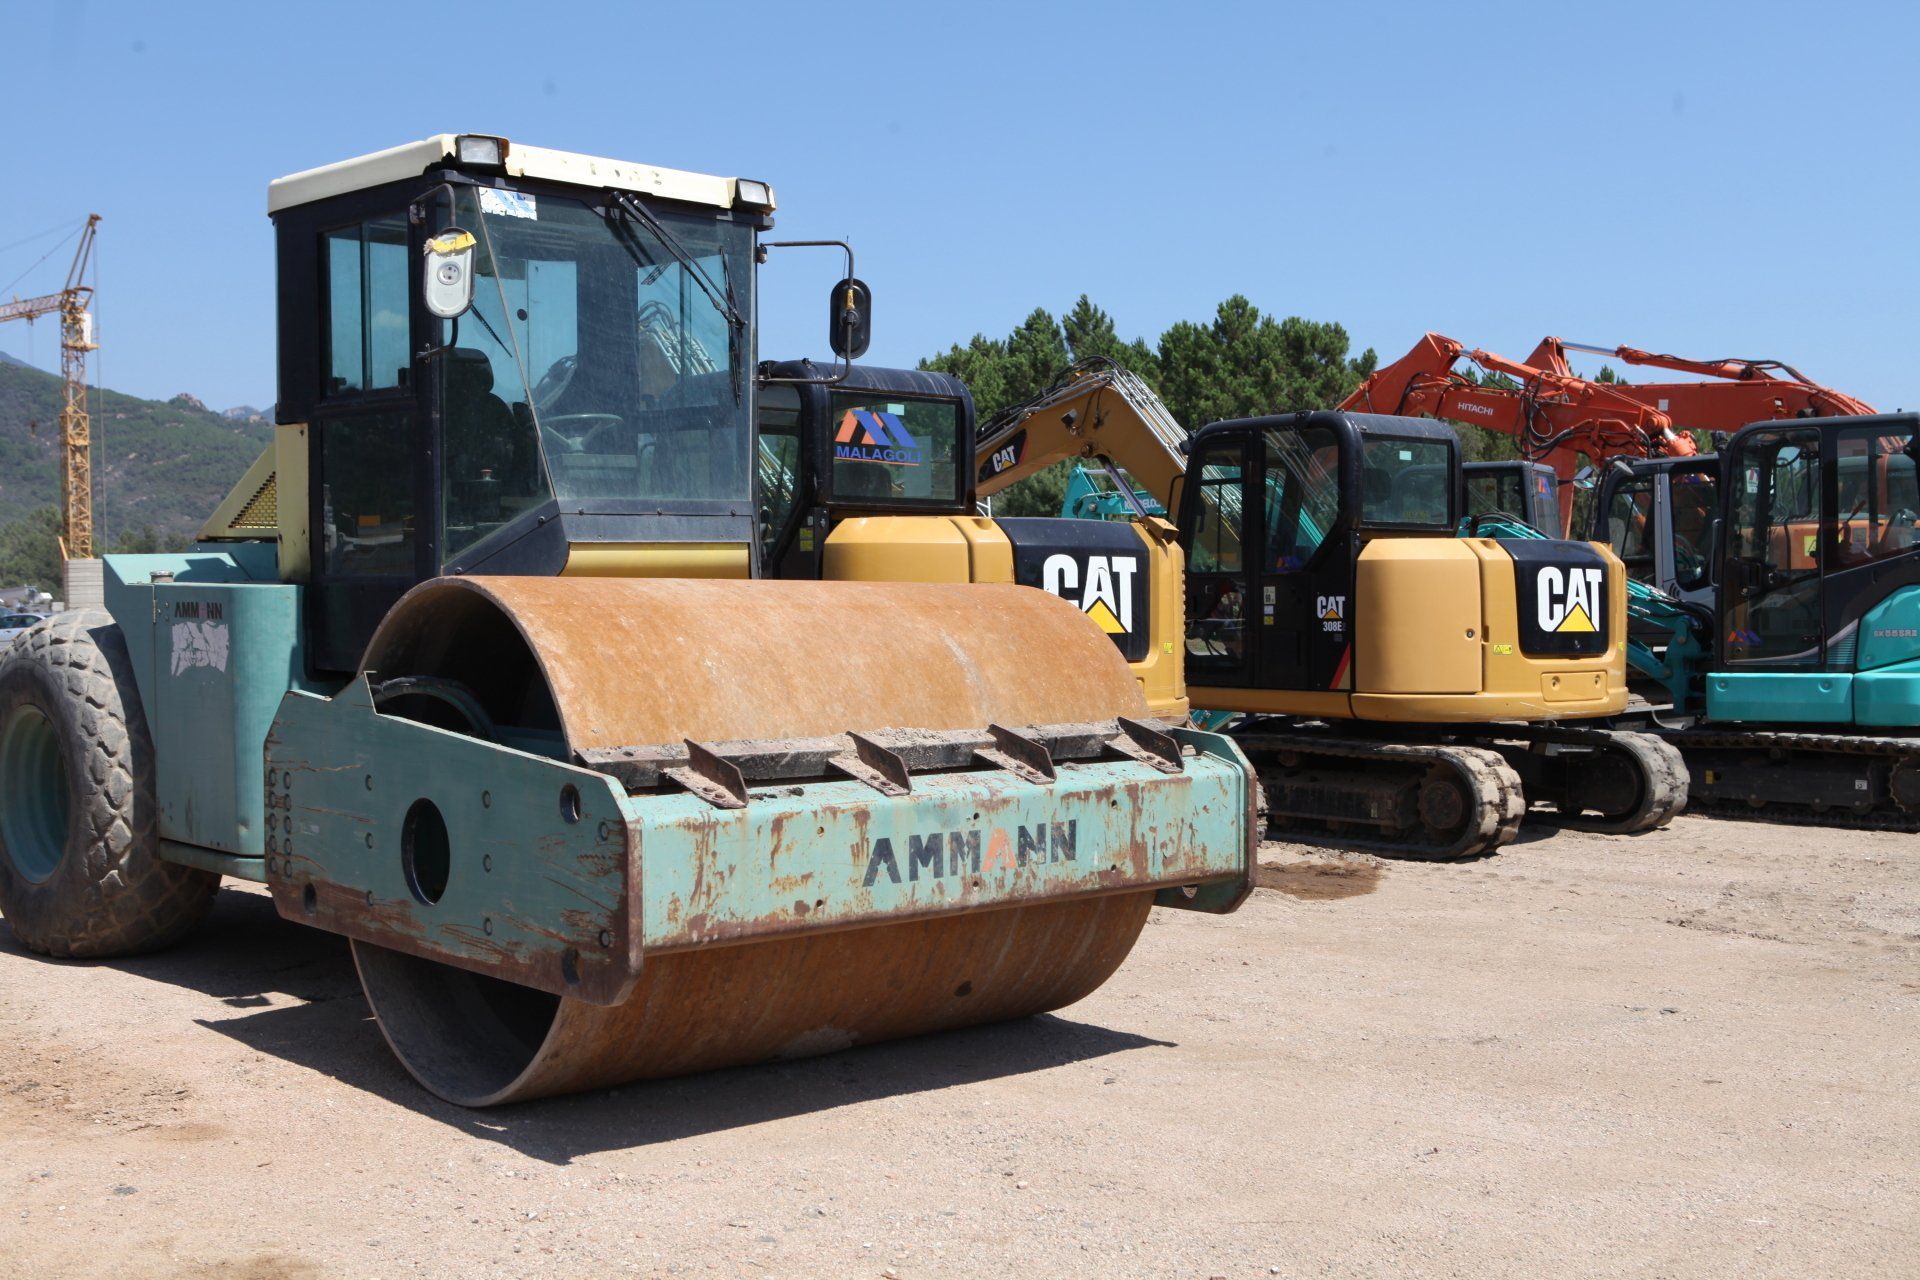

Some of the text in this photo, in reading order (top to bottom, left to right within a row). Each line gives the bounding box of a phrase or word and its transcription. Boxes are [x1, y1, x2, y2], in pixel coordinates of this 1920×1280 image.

[1457, 402, 1494, 416] HITACHI
[992, 445, 1016, 473] CAT
[1043, 553, 1137, 633] CAT
[1316, 595, 1346, 619] CAT
[1537, 566, 1603, 632] CAT
[862, 819, 1078, 887] AMMANN
